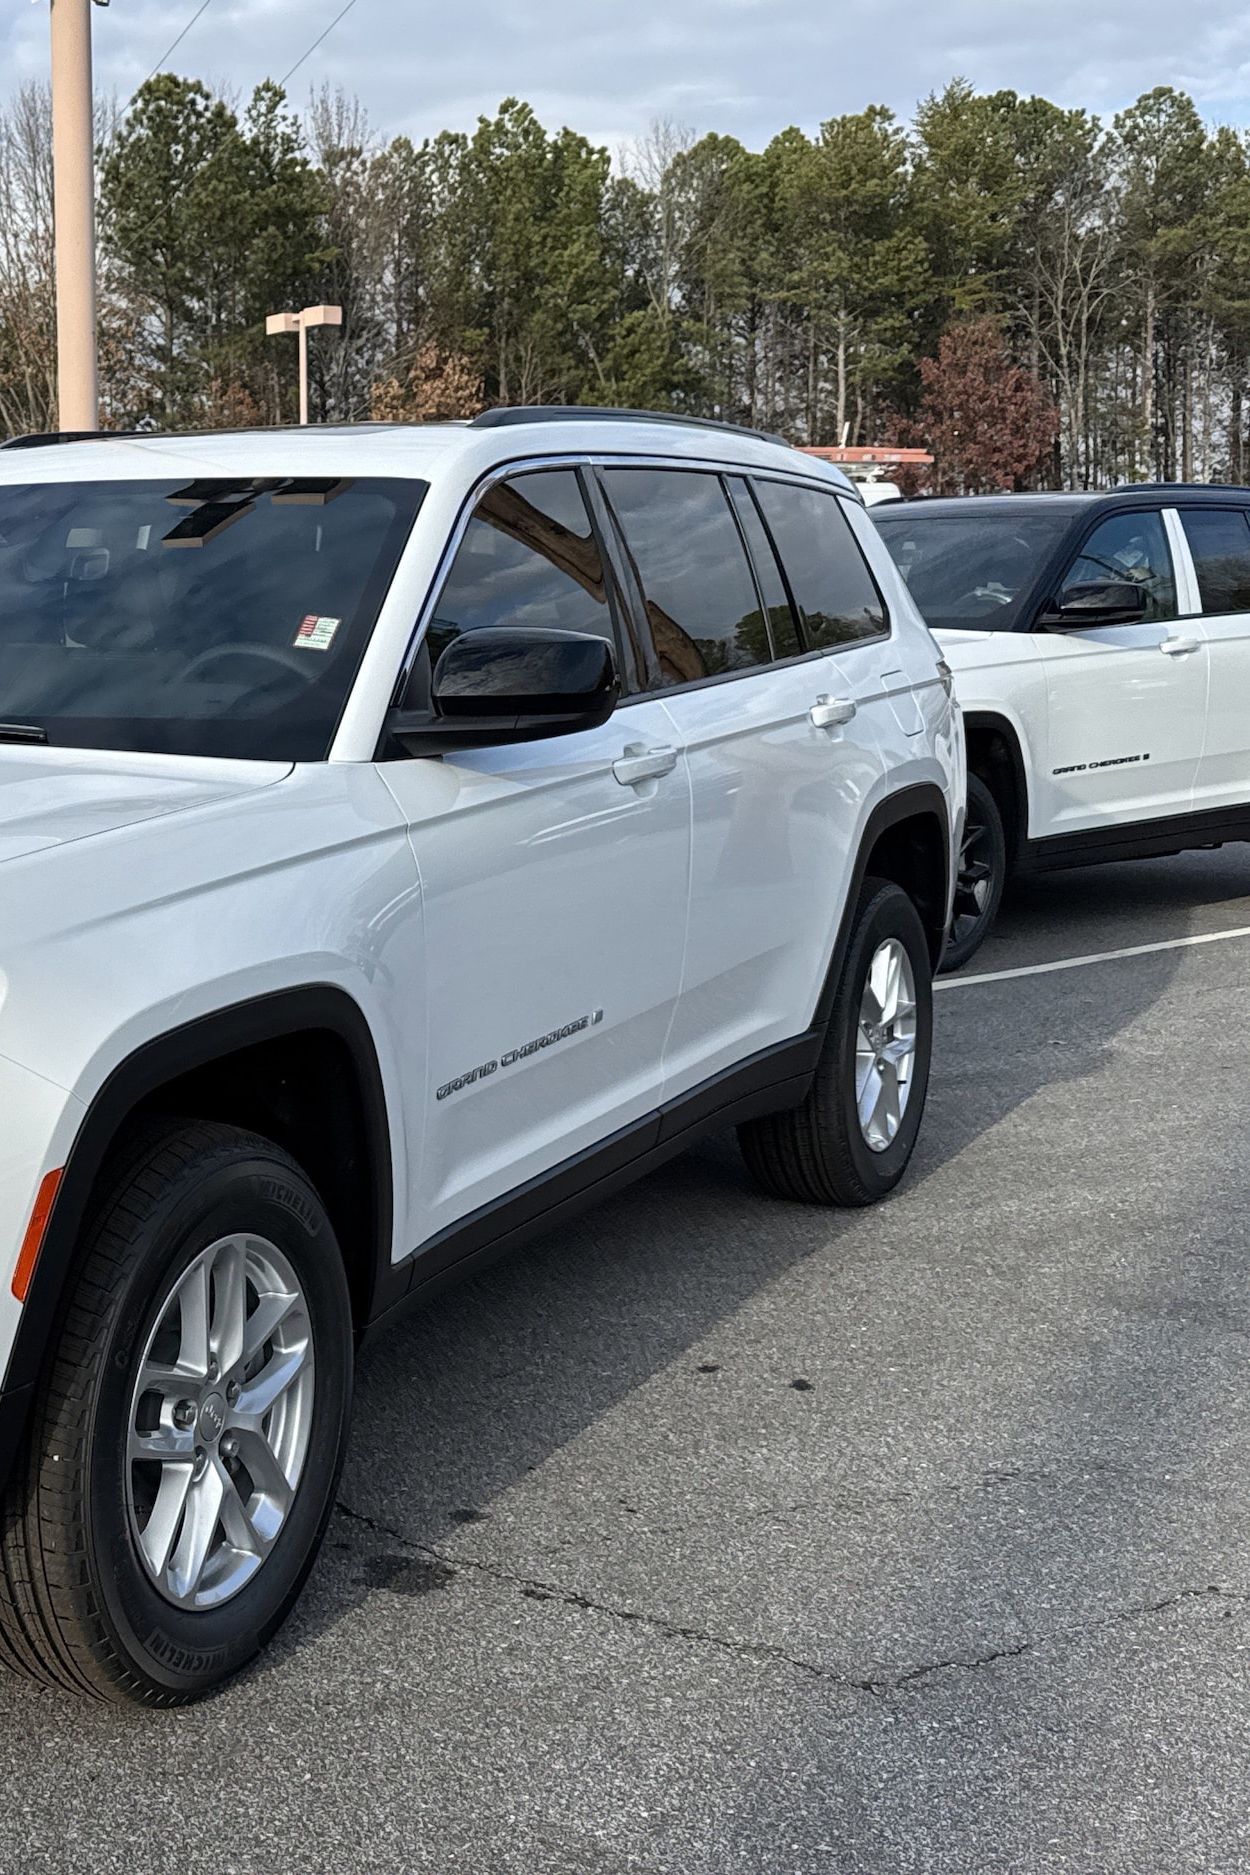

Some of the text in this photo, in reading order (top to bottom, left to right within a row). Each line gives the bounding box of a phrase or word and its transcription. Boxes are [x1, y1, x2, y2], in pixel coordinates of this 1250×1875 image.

[1052, 763, 1087, 775] GRAND
[1088, 754, 1141, 769] CHEROKEE
[436, 1015, 590, 1101] GRAND CHEROKEE
[260, 1178, 321, 1231] MICHELIN
[149, 1633, 226, 1672] MICHELIN
